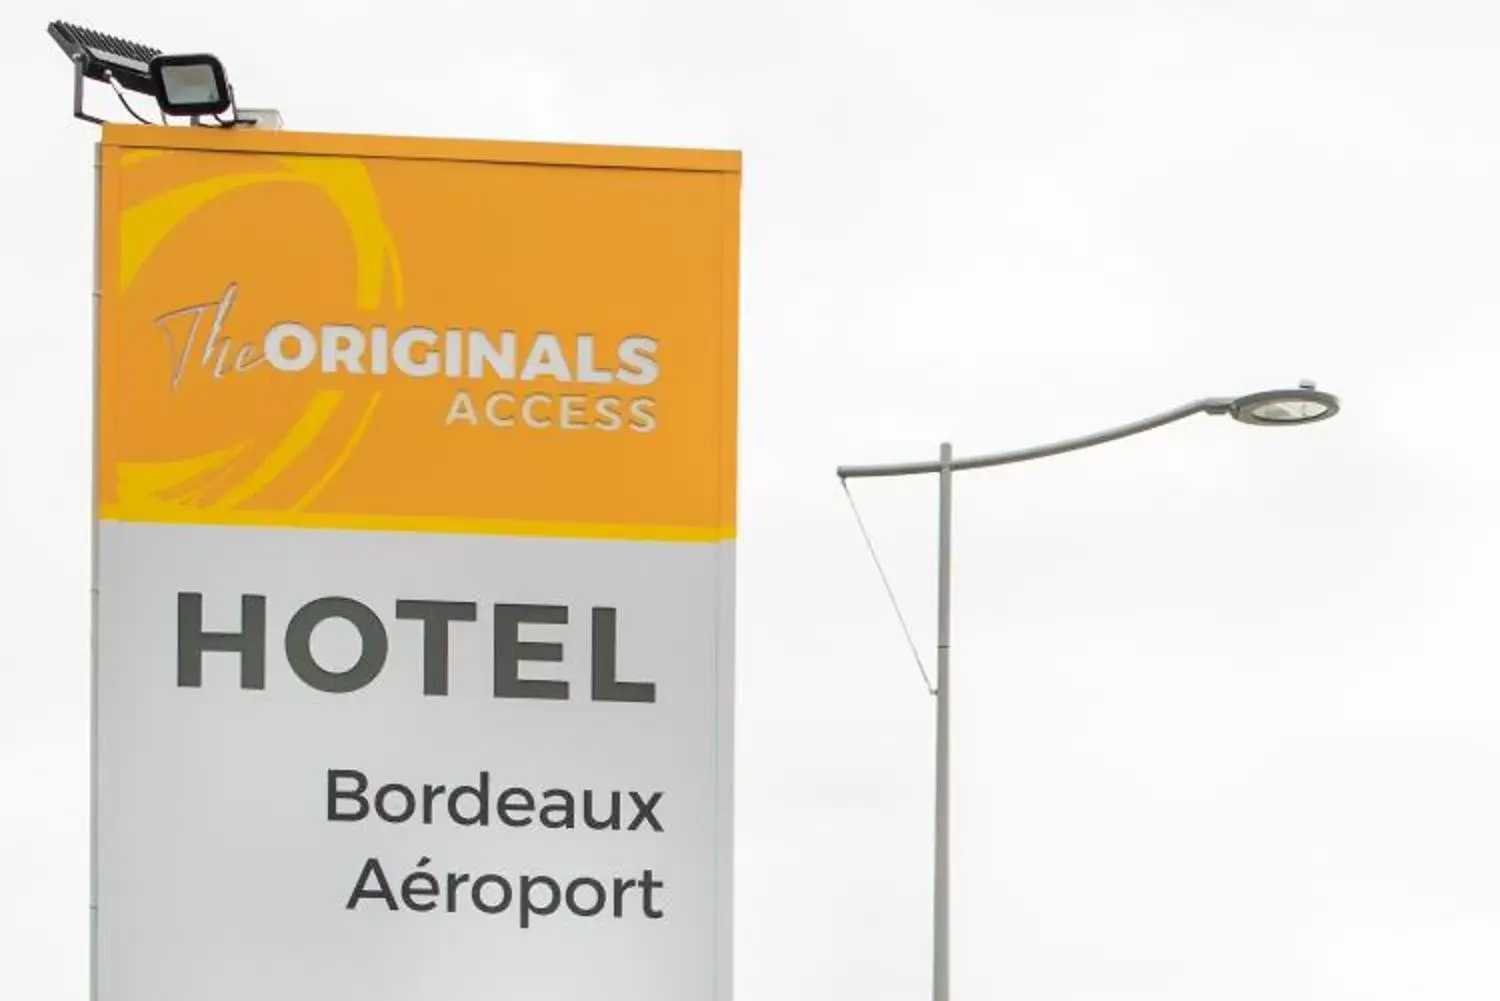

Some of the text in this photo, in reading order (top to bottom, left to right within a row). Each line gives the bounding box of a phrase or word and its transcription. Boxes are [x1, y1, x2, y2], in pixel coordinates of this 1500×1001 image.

[154, 282, 660, 391] The ORIGINALS
[445, 388, 659, 433] ACCESS
[177, 592, 656, 703] HOTEL
[328, 769, 664, 832] Bordeaux
[346, 857, 663, 928] Aéroport
